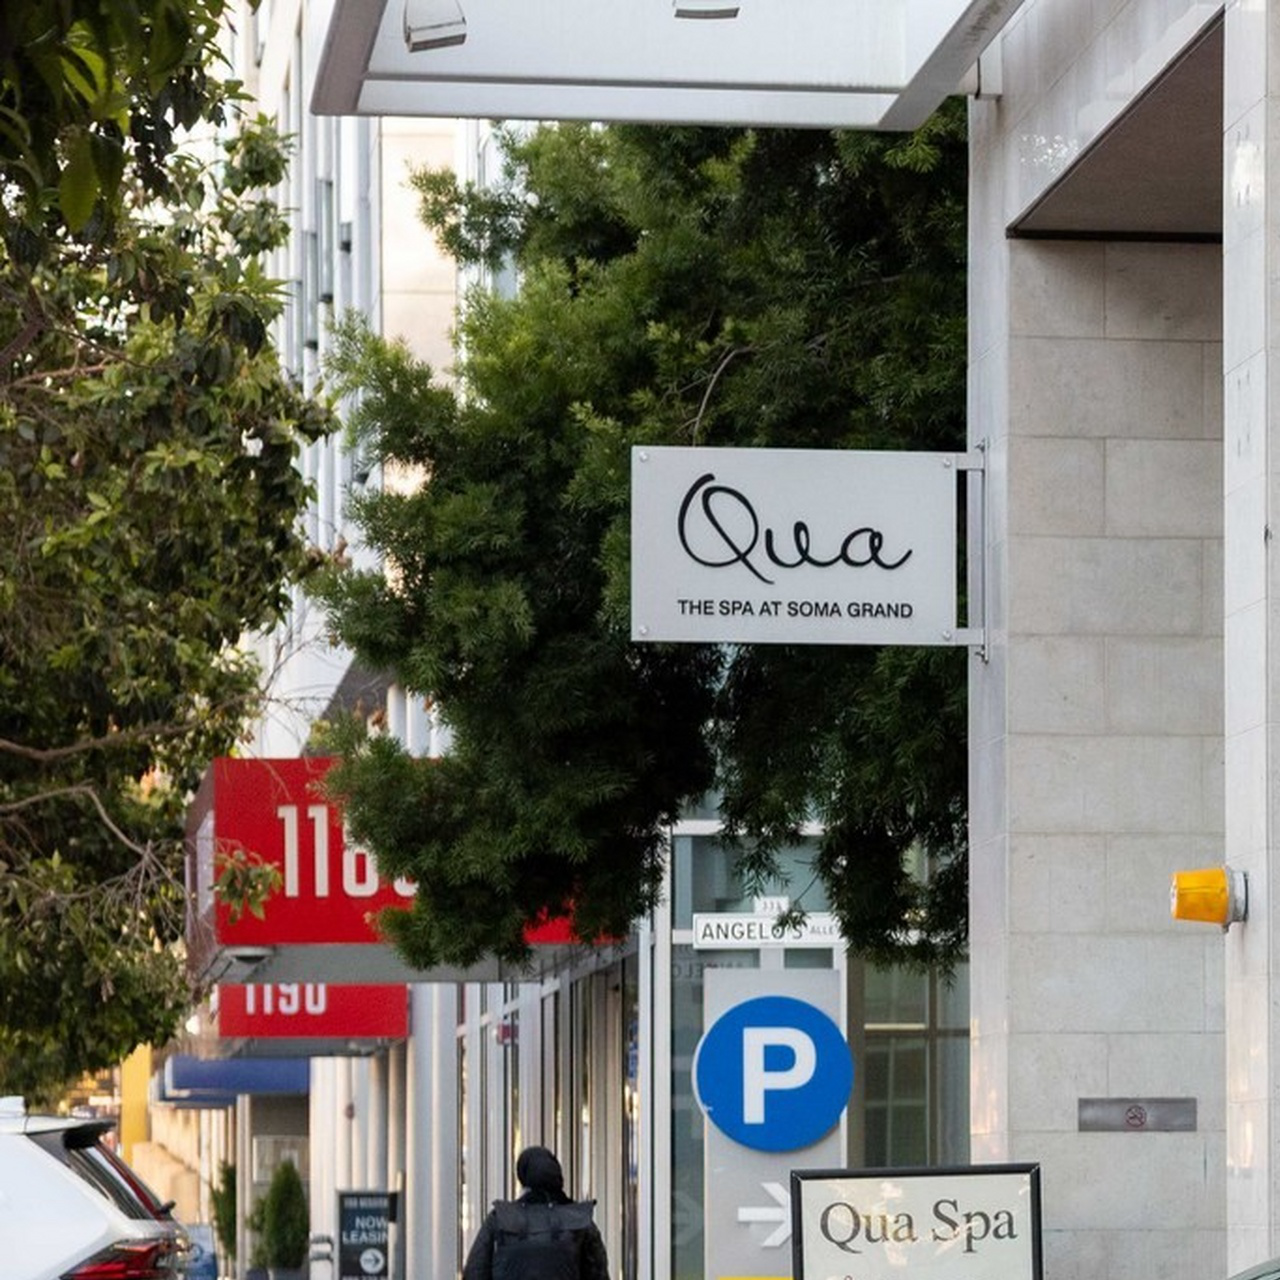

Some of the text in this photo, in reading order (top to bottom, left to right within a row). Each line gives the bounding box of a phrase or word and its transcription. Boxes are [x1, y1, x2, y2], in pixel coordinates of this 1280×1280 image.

[677, 472, 913, 585] Qua
[677, 600, 914, 619] THE SPA AT SOMA GRAND
[277, 804, 420, 897] 118
[701, 922, 803, 940] ANGELOS
[743, 1026, 817, 1125] P
[342, 1231, 388, 1245] LEASIN
[819, 1199, 1018, 1255] Qua Spa
